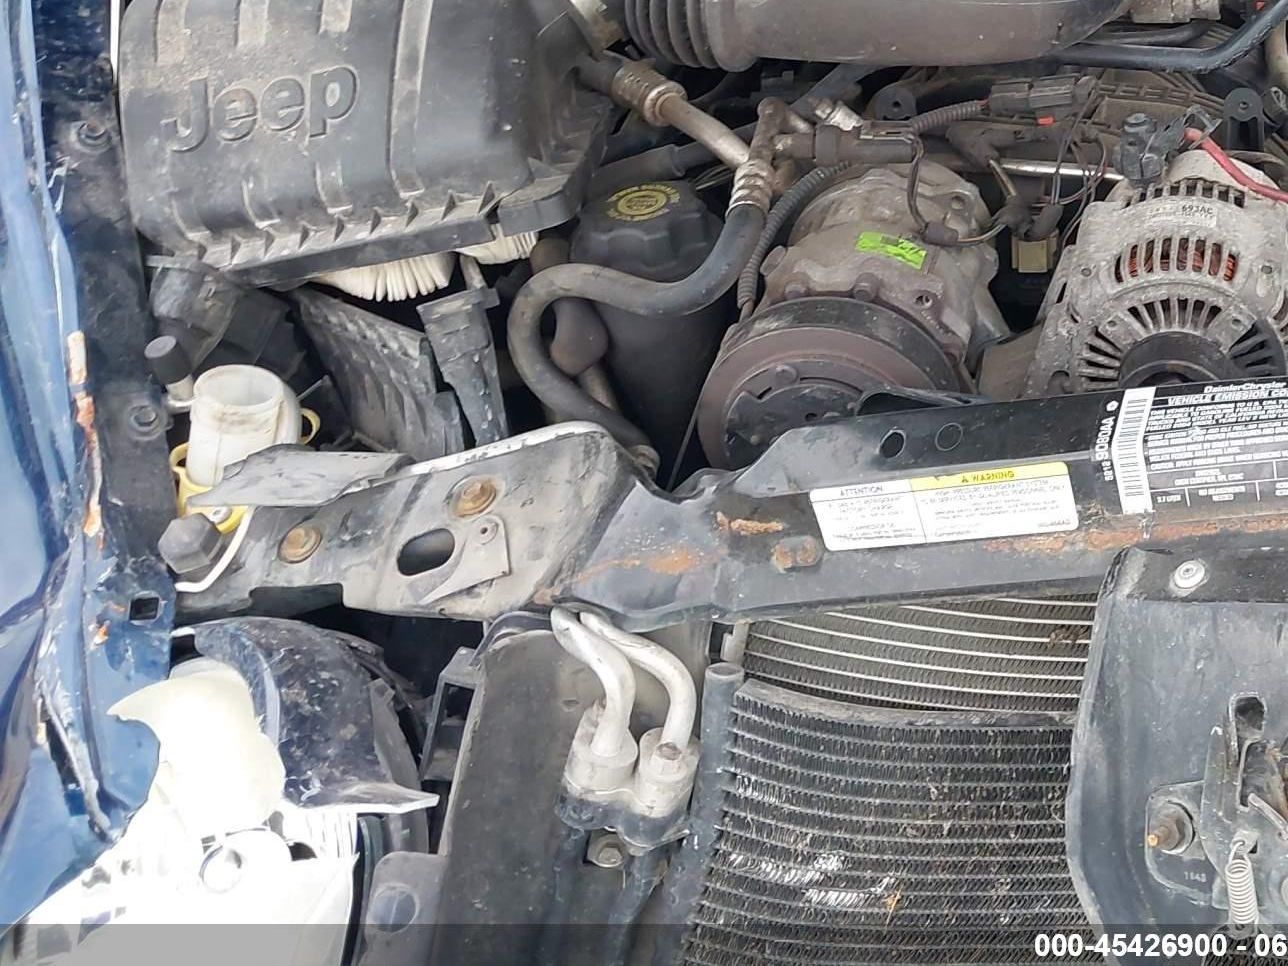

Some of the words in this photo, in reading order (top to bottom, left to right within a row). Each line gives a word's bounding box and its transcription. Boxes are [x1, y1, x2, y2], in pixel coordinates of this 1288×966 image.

[158, 65, 359, 153] Jeep
[1203, 381, 1287, 394] DaimlerChrysler
[1167, 394, 1212, 406] VEHICLE
[1214, 389, 1270, 403] EMISSION
[972, 470, 1015, 483] WARNING
